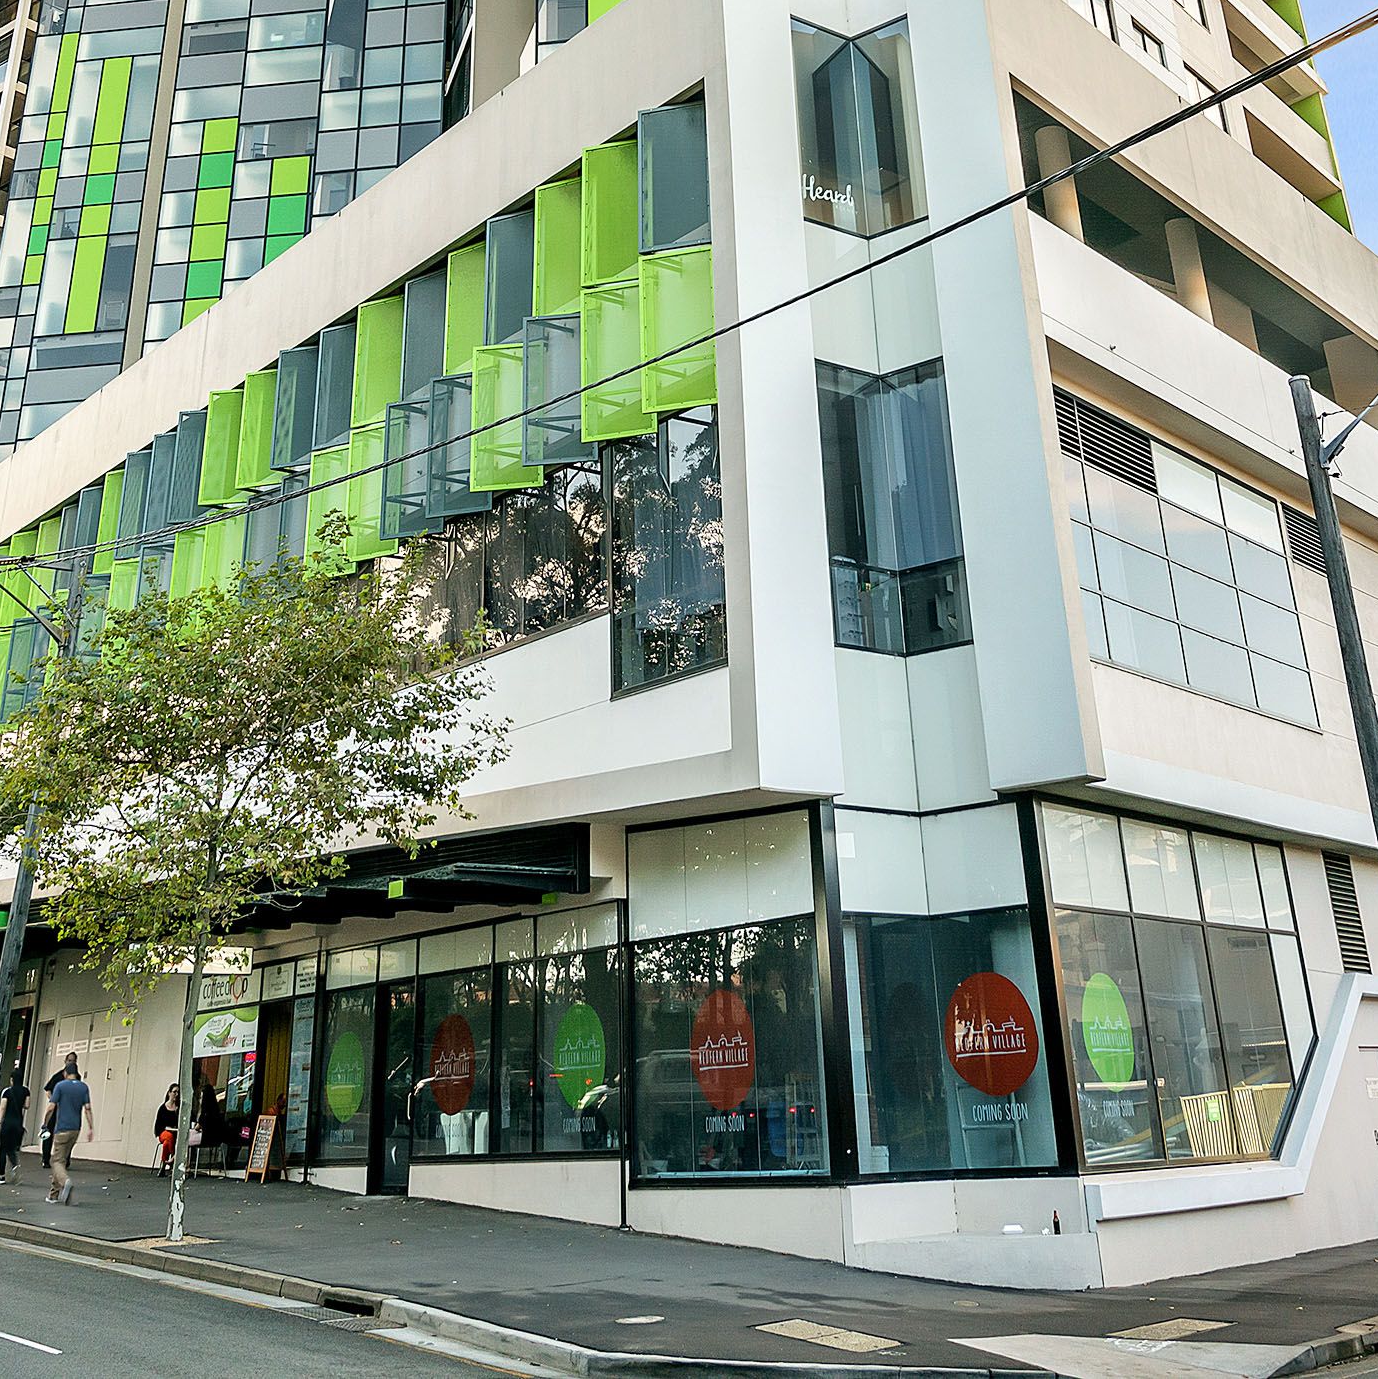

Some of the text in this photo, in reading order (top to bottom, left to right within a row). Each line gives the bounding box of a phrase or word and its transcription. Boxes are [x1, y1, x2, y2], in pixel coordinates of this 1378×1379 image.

[802, 173, 855, 207] Heard
[955, 1033, 1026, 1053] REDFERN VILLAGE
[699, 1047, 748, 1064] REDFERN VILLAGE
[972, 1102, 1029, 1122] COMING SOON
[705, 1115, 745, 1133] COMING SOON
